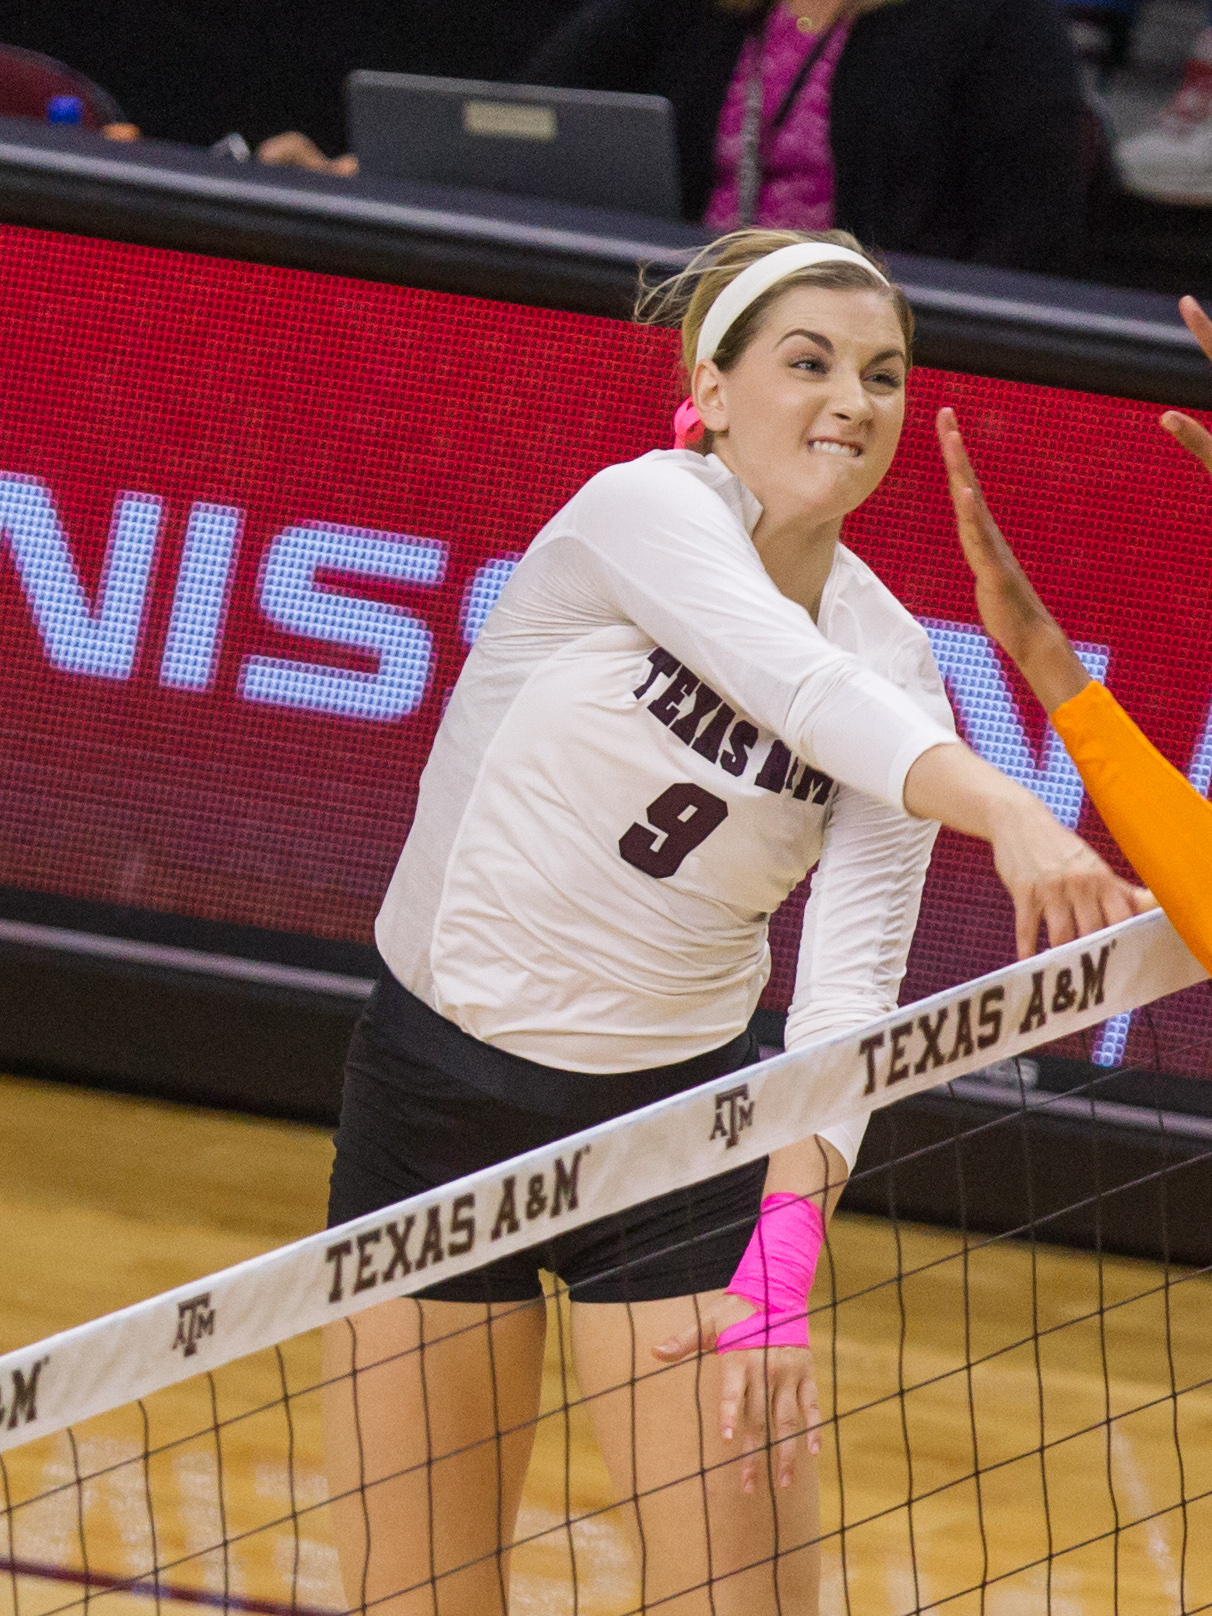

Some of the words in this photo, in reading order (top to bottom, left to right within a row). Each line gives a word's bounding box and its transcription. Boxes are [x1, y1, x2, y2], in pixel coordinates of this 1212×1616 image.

[633, 647, 758, 777] TEXAS
[618, 782, 729, 879] 9
[859, 985, 1005, 1096] TEXAS
[325, 1193, 477, 1303] TEXAS
